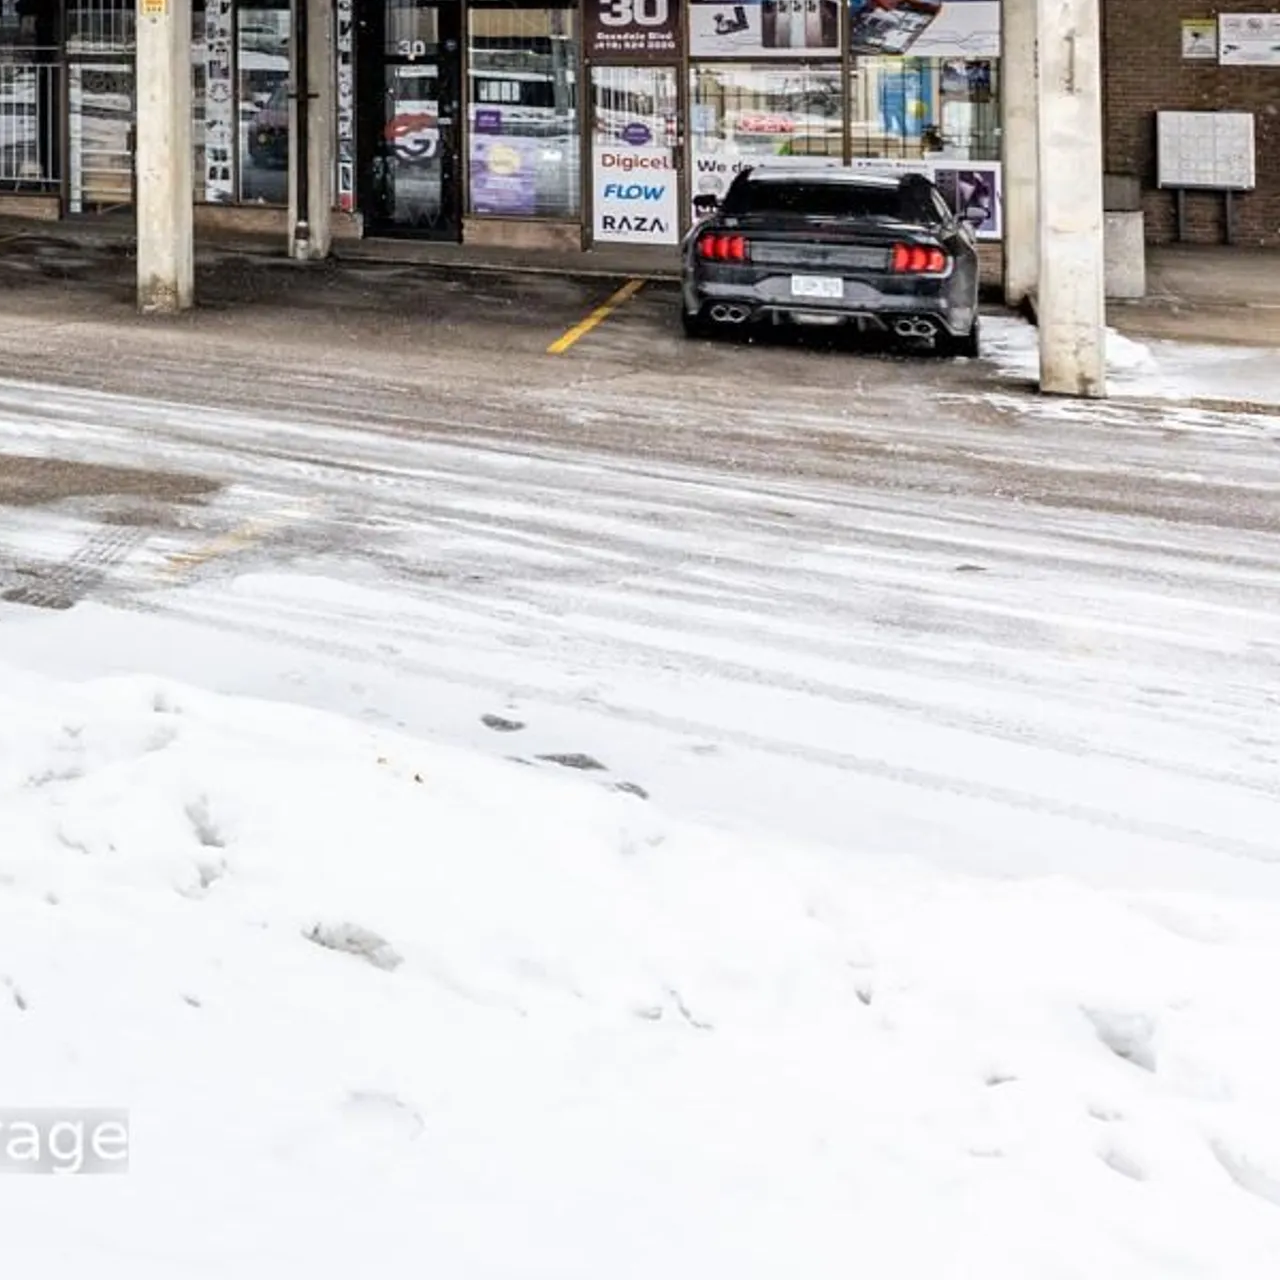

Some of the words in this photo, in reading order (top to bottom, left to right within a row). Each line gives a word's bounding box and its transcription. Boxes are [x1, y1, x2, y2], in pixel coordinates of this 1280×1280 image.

[398, 40, 426, 57] 30
[601, 153, 669, 172] Digicel
[697, 159, 727, 173] We
[603, 183, 665, 201] FLOW
[602, 215, 666, 234] RAZA
